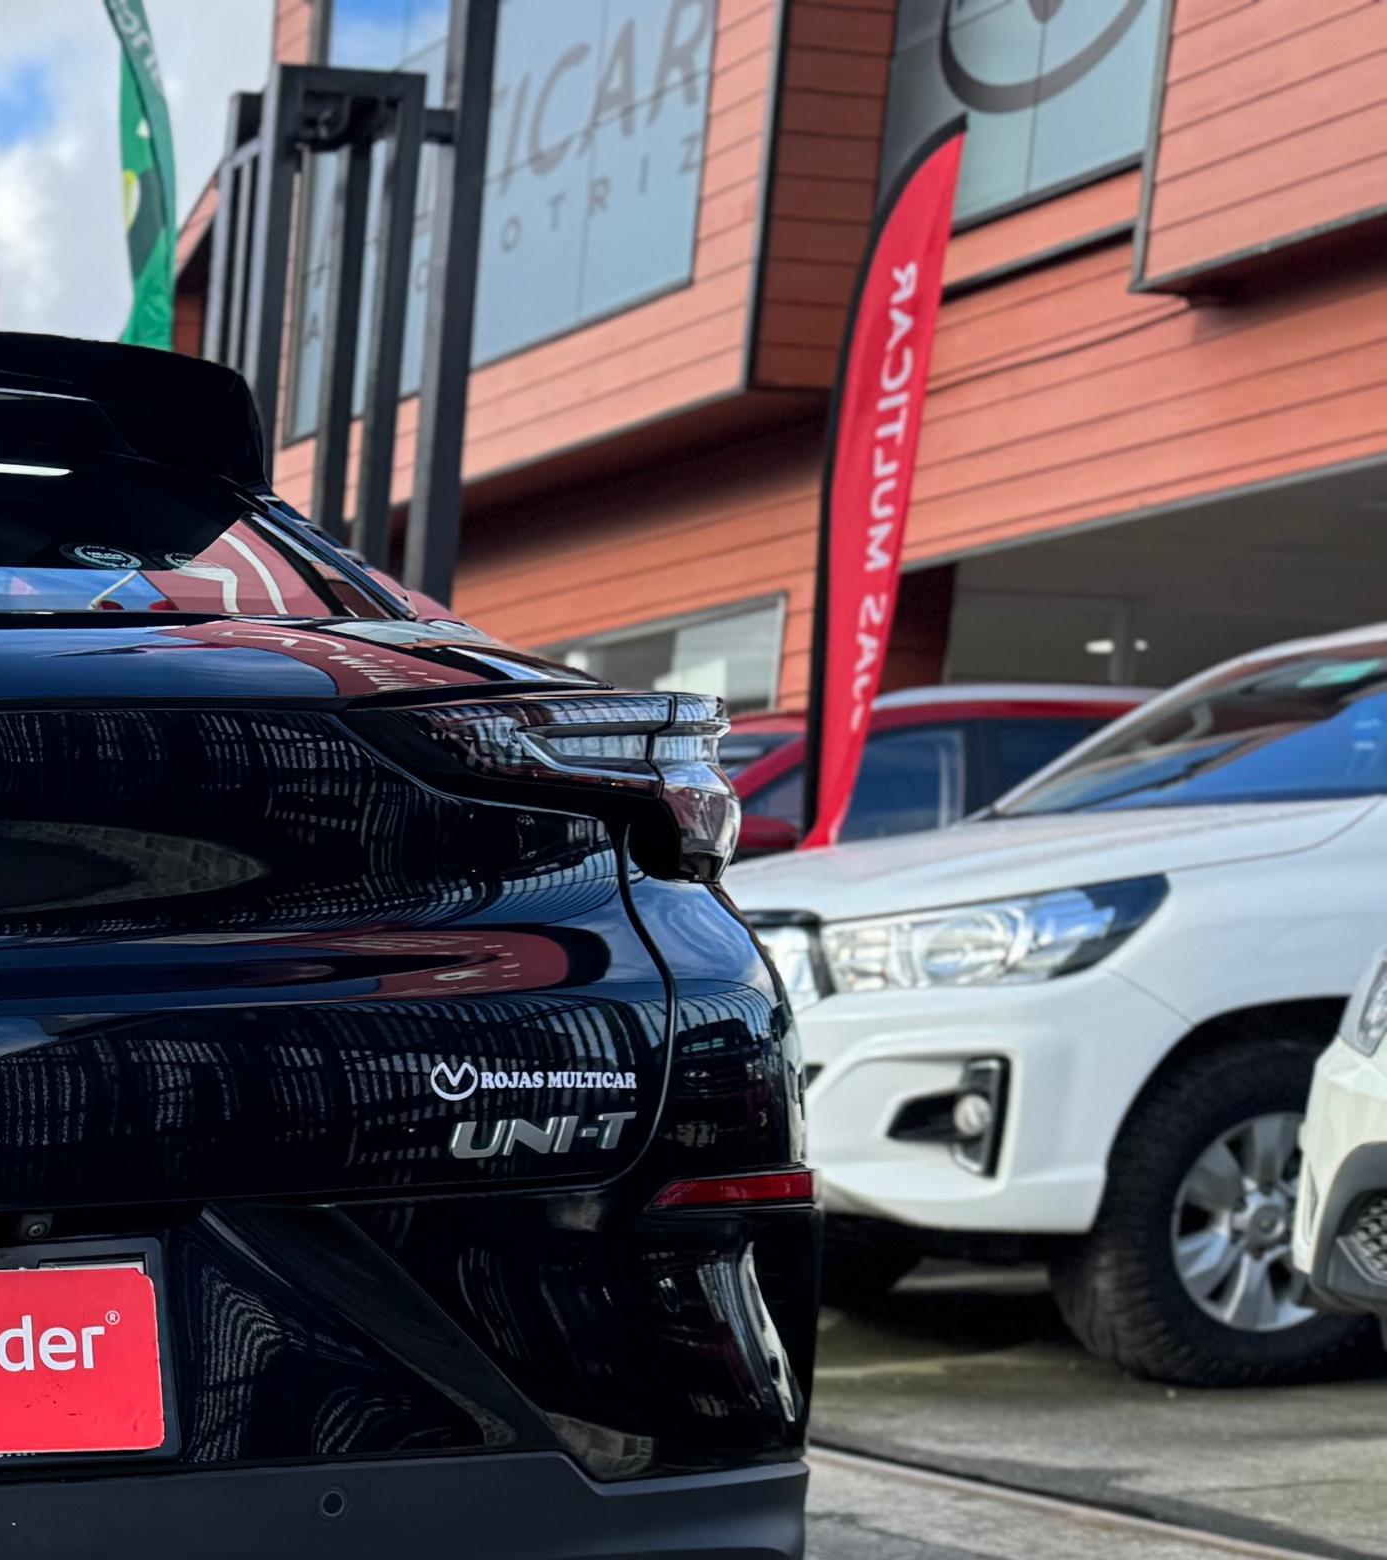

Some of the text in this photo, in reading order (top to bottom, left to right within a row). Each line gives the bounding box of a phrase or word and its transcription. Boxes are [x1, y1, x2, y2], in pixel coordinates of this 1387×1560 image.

[480, 1071, 637, 1089] ROJAS MULTICAR
[451, 1111, 637, 1159] UNI-T
